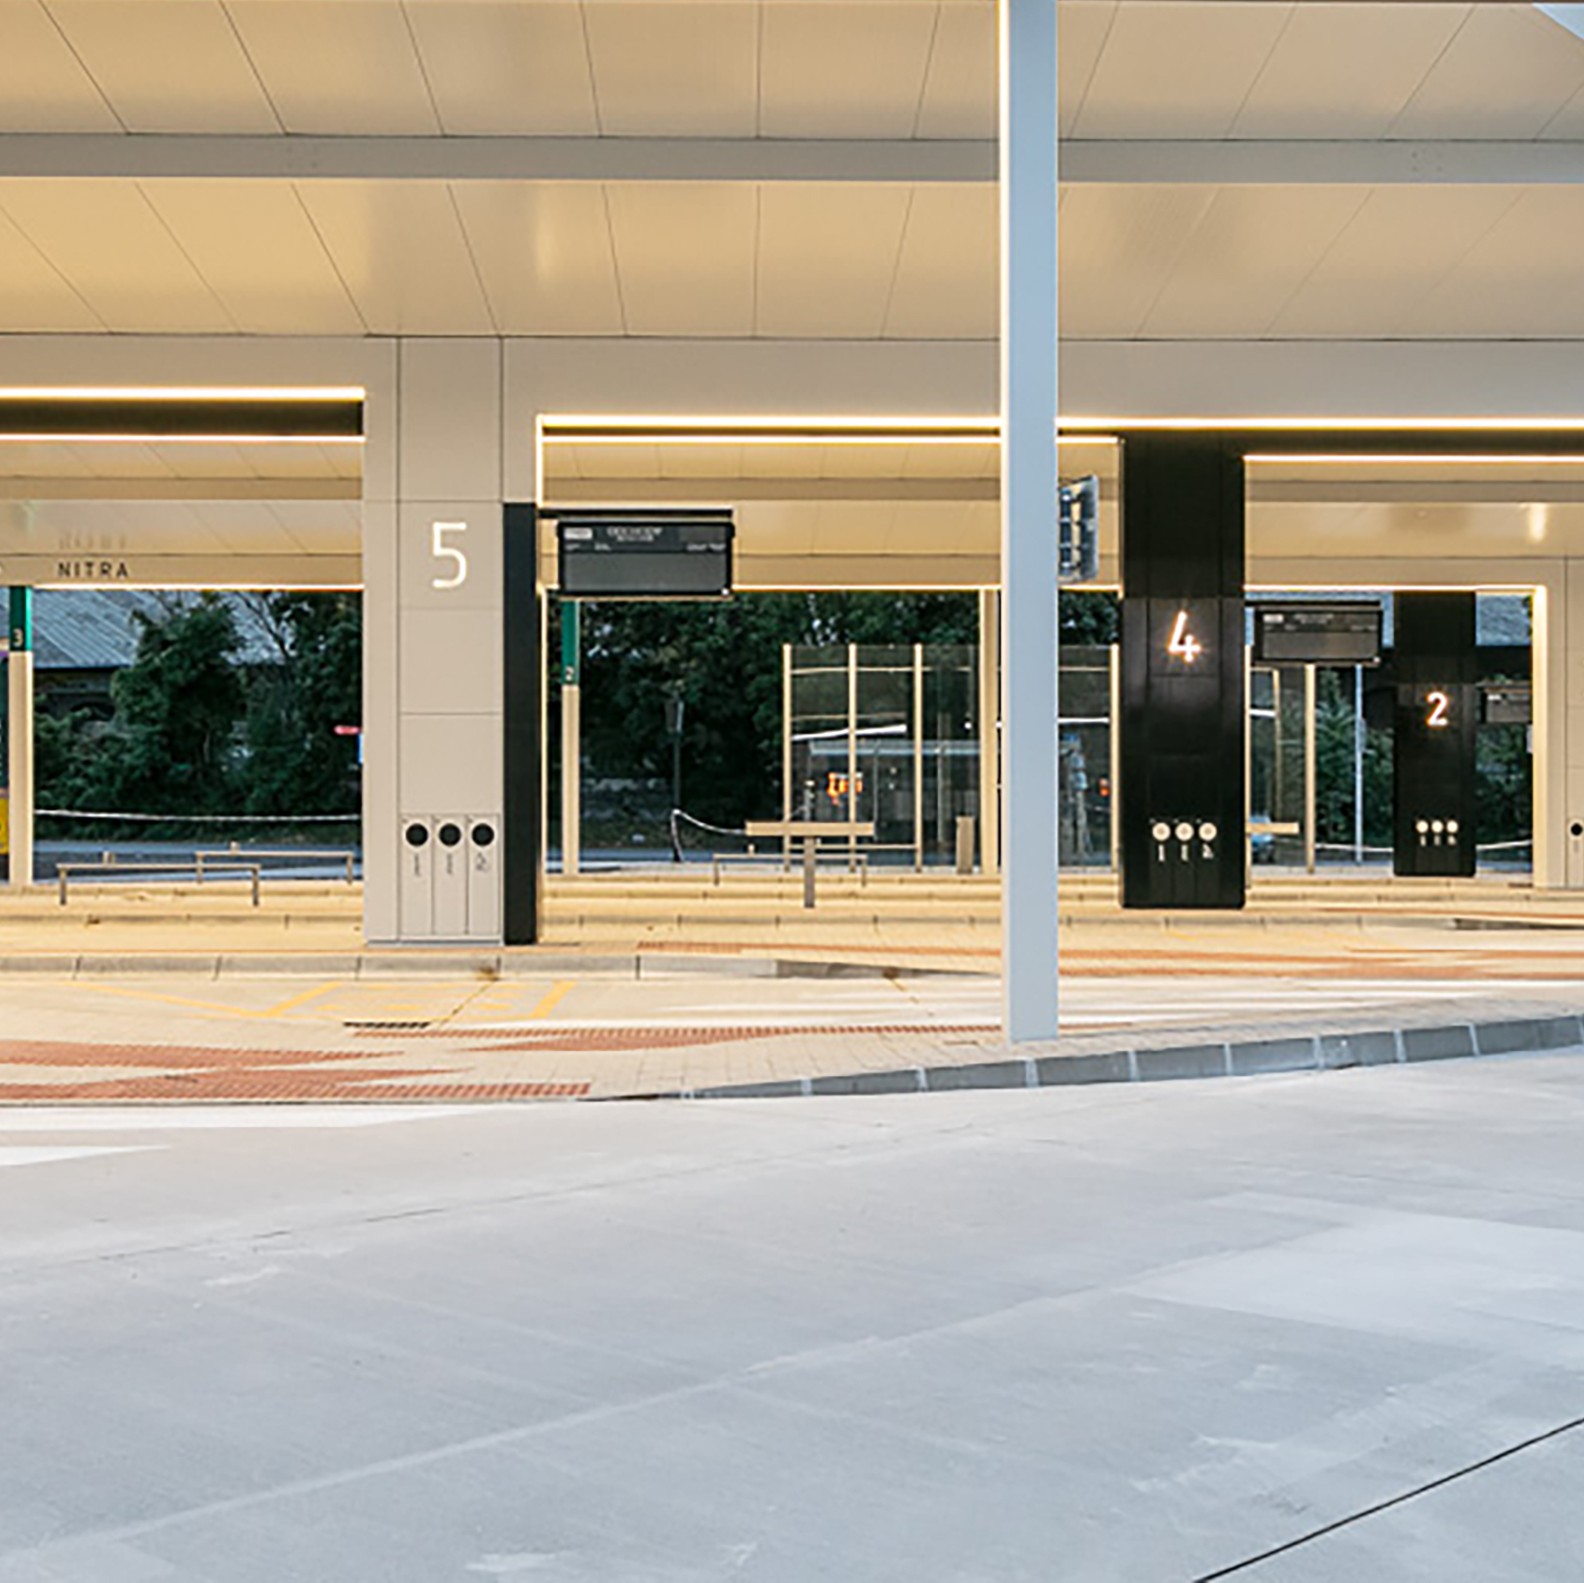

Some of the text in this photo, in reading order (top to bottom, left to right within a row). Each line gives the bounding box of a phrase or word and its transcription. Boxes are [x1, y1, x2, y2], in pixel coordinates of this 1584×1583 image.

[58, 561, 128, 577] NITRA
[432, 521, 468, 588] 5
[14, 628, 24, 647] 3
[1167, 610, 1202, 663] 4
[1426, 691, 1449, 727] 2
